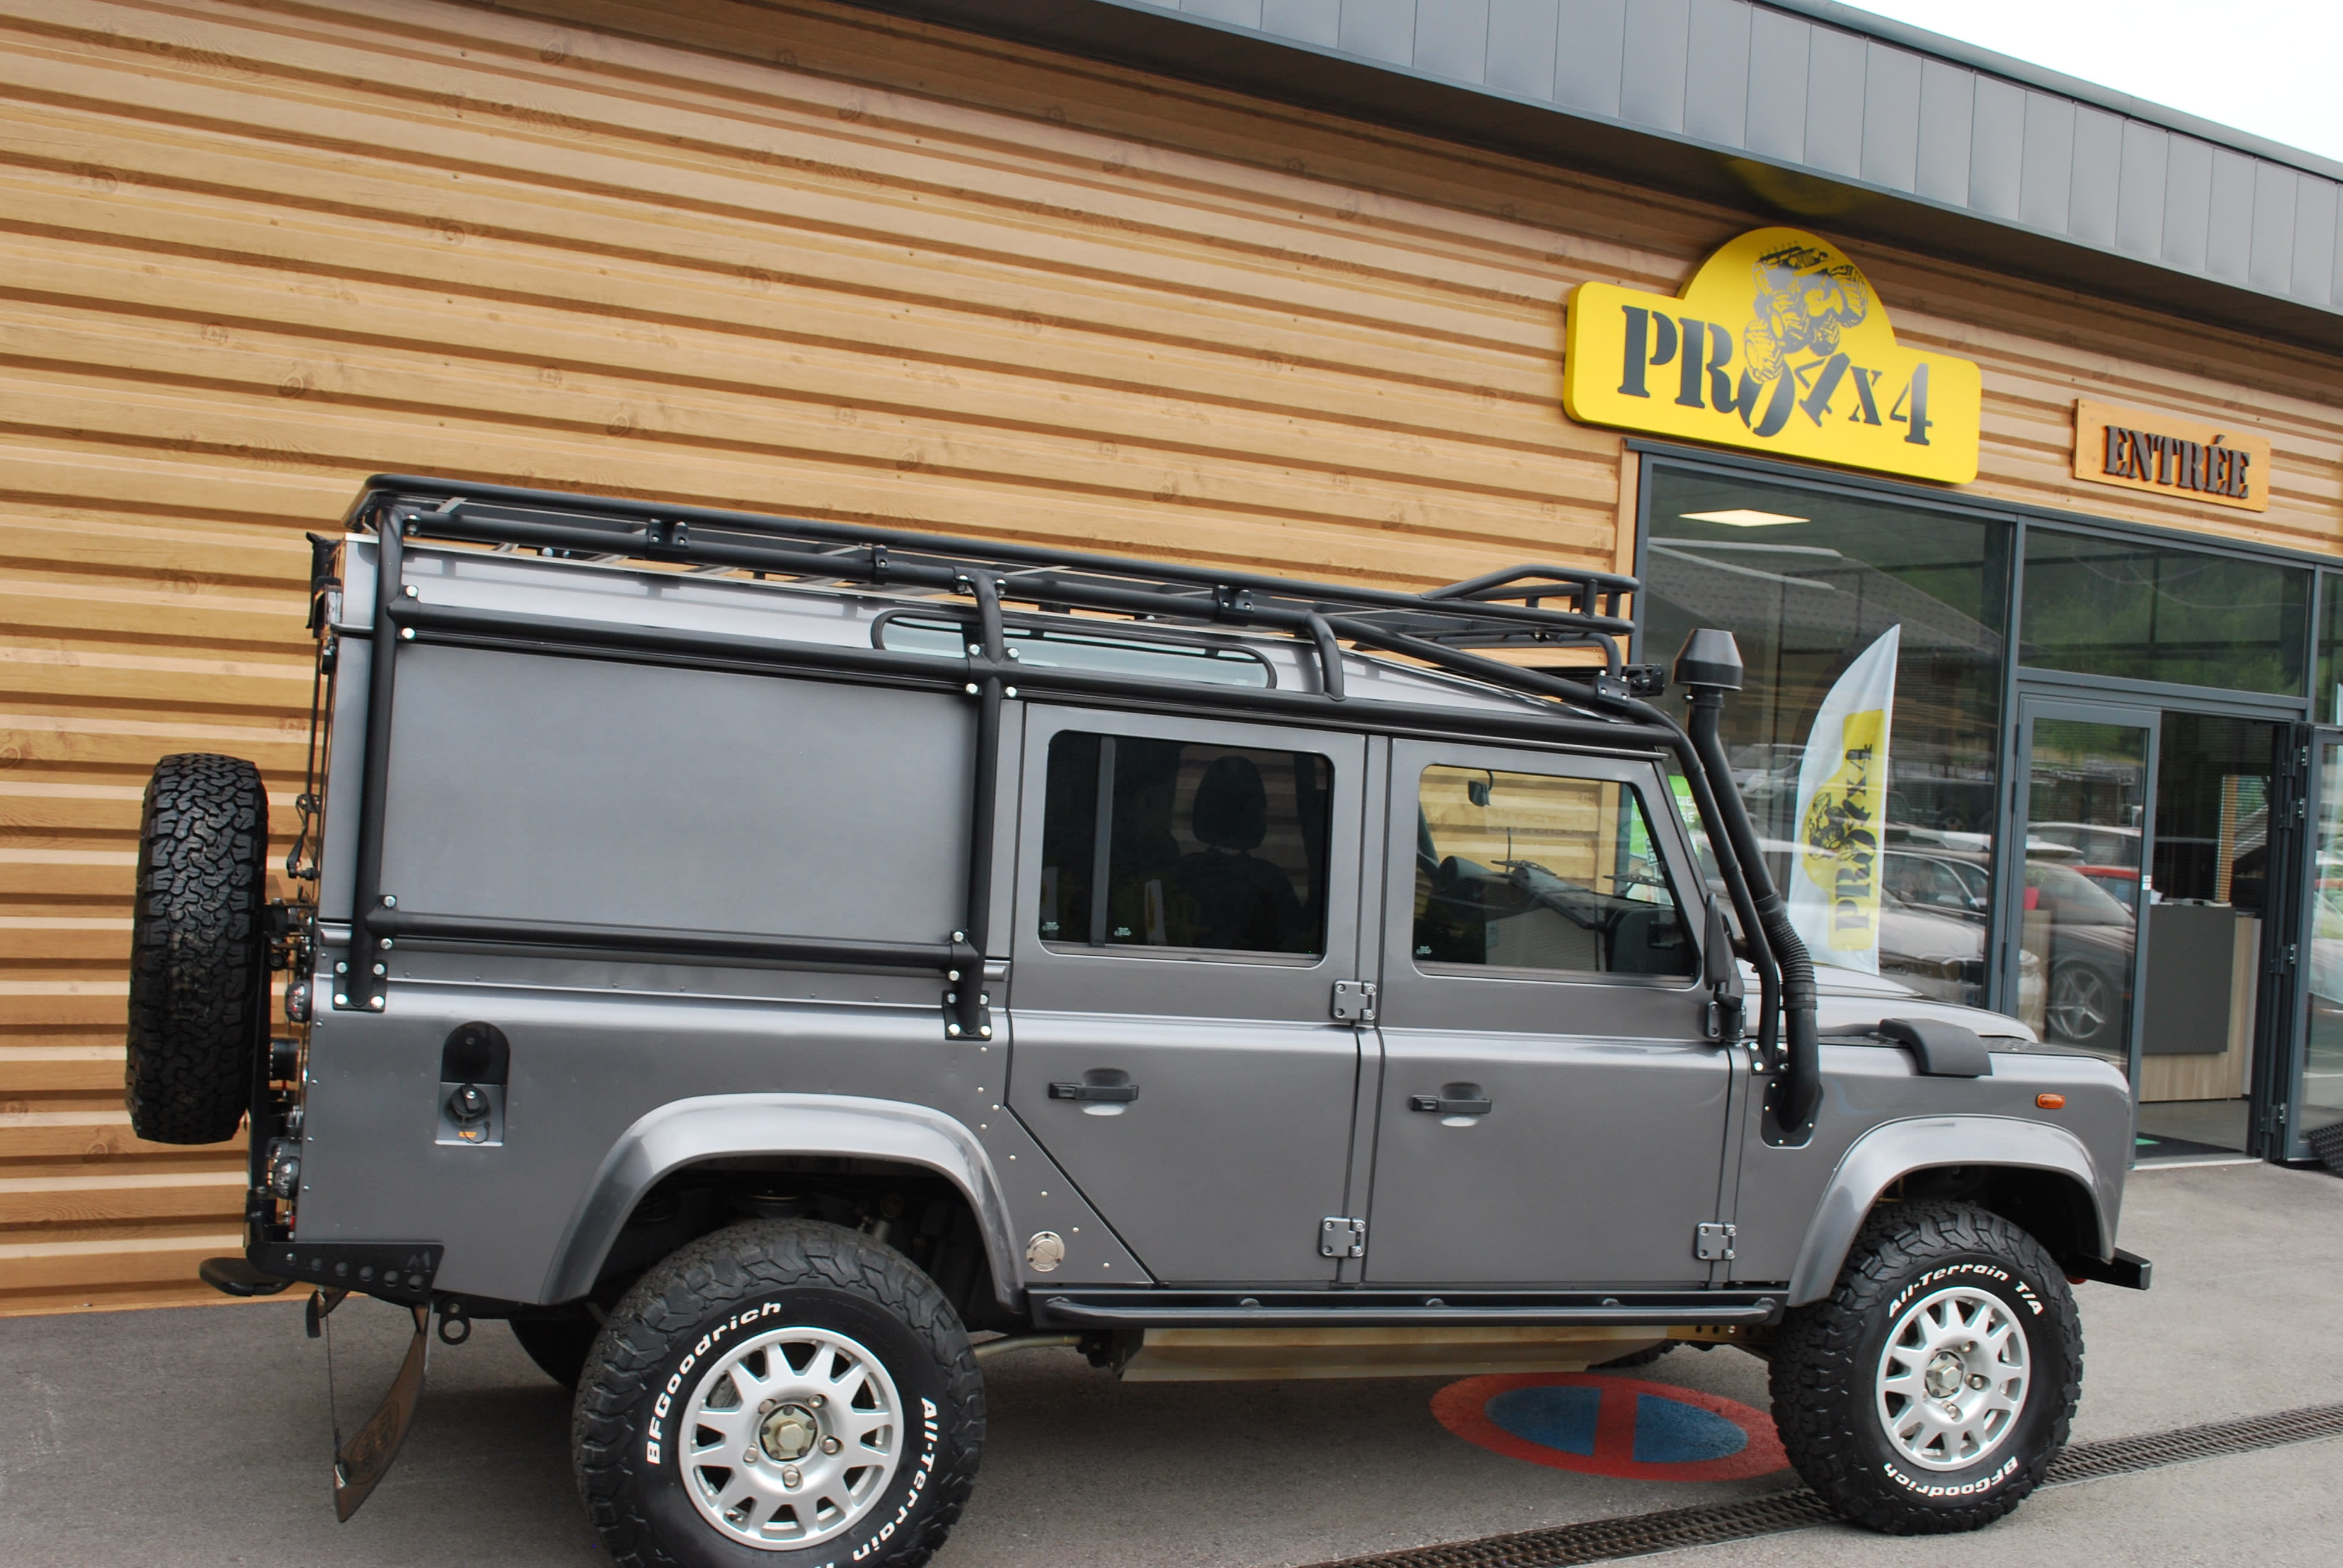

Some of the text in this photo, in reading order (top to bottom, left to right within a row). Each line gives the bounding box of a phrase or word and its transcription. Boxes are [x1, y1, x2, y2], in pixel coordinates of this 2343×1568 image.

[2103, 425, 2250, 499] ENTRÉE
[1889, 1264, 2045, 1318] All-Terrain T/A
[646, 1302, 782, 1465] BFGoodrich
[853, 1397, 939, 1561] All-Terrain
[1883, 1455, 2019, 1498] BFGoodrich
